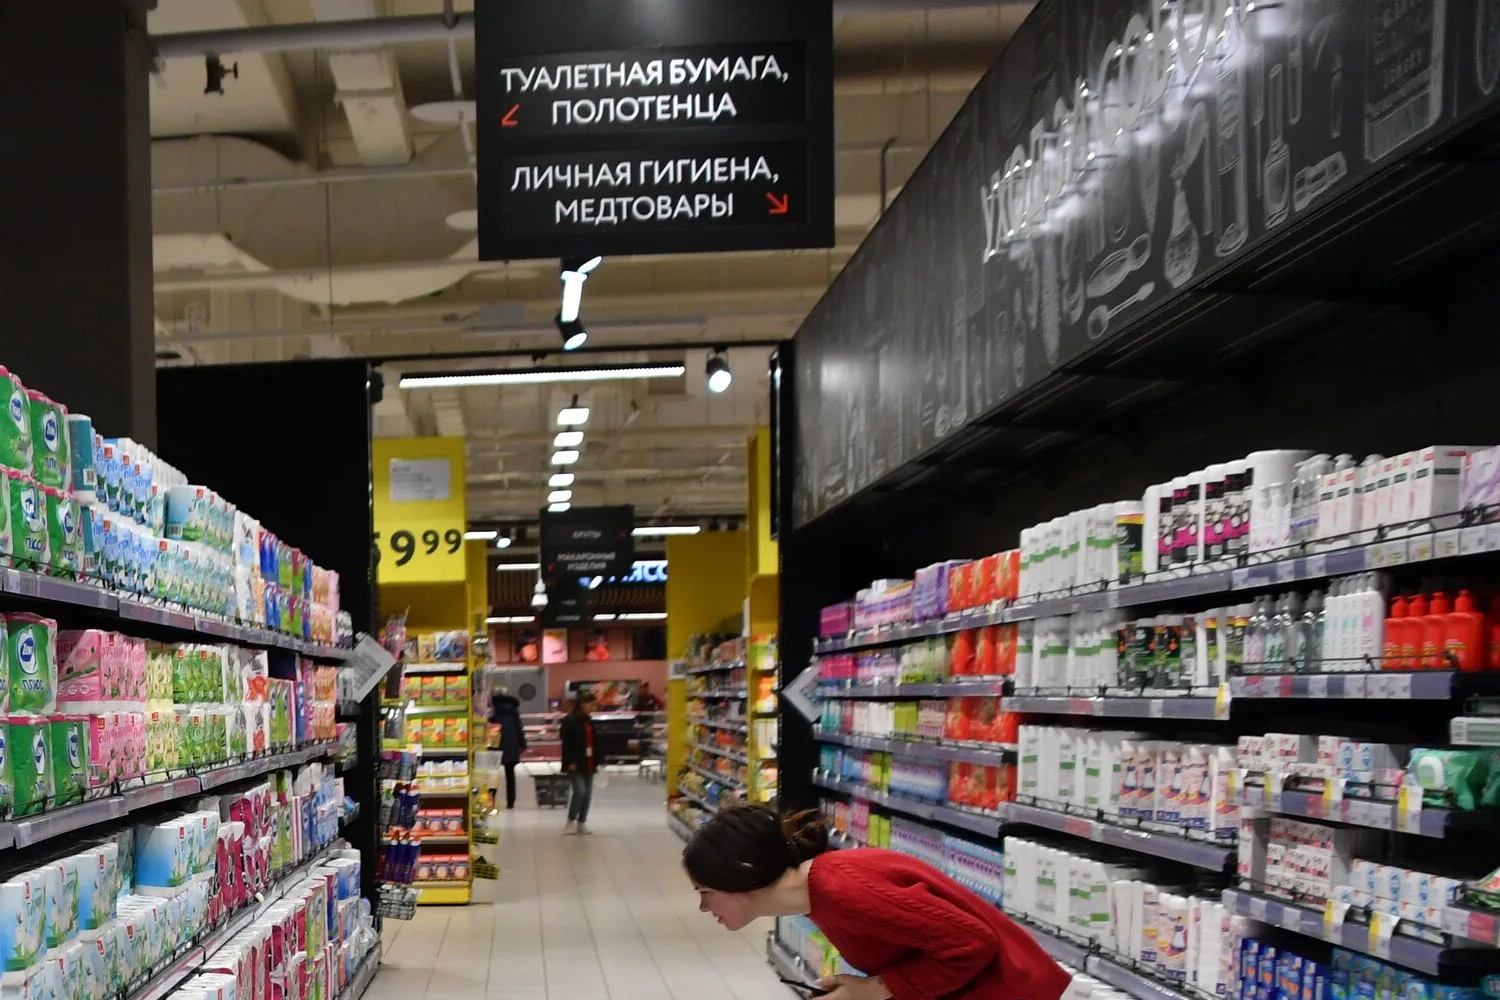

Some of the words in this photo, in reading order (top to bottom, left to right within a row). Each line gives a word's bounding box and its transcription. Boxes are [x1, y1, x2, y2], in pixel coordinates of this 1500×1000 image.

[501, 59, 663, 93] ТУАЛЕТНАЯ
[669, 55, 789, 86] БУМАГА,
[551, 92, 737, 126] ПОЛОТЕНЦА
[511, 160, 631, 191] ЛИЧНАЯ
[639, 156, 780, 185] ГИГИЕНА,
[555, 192, 734, 225] МЕДТОВАРЫ
